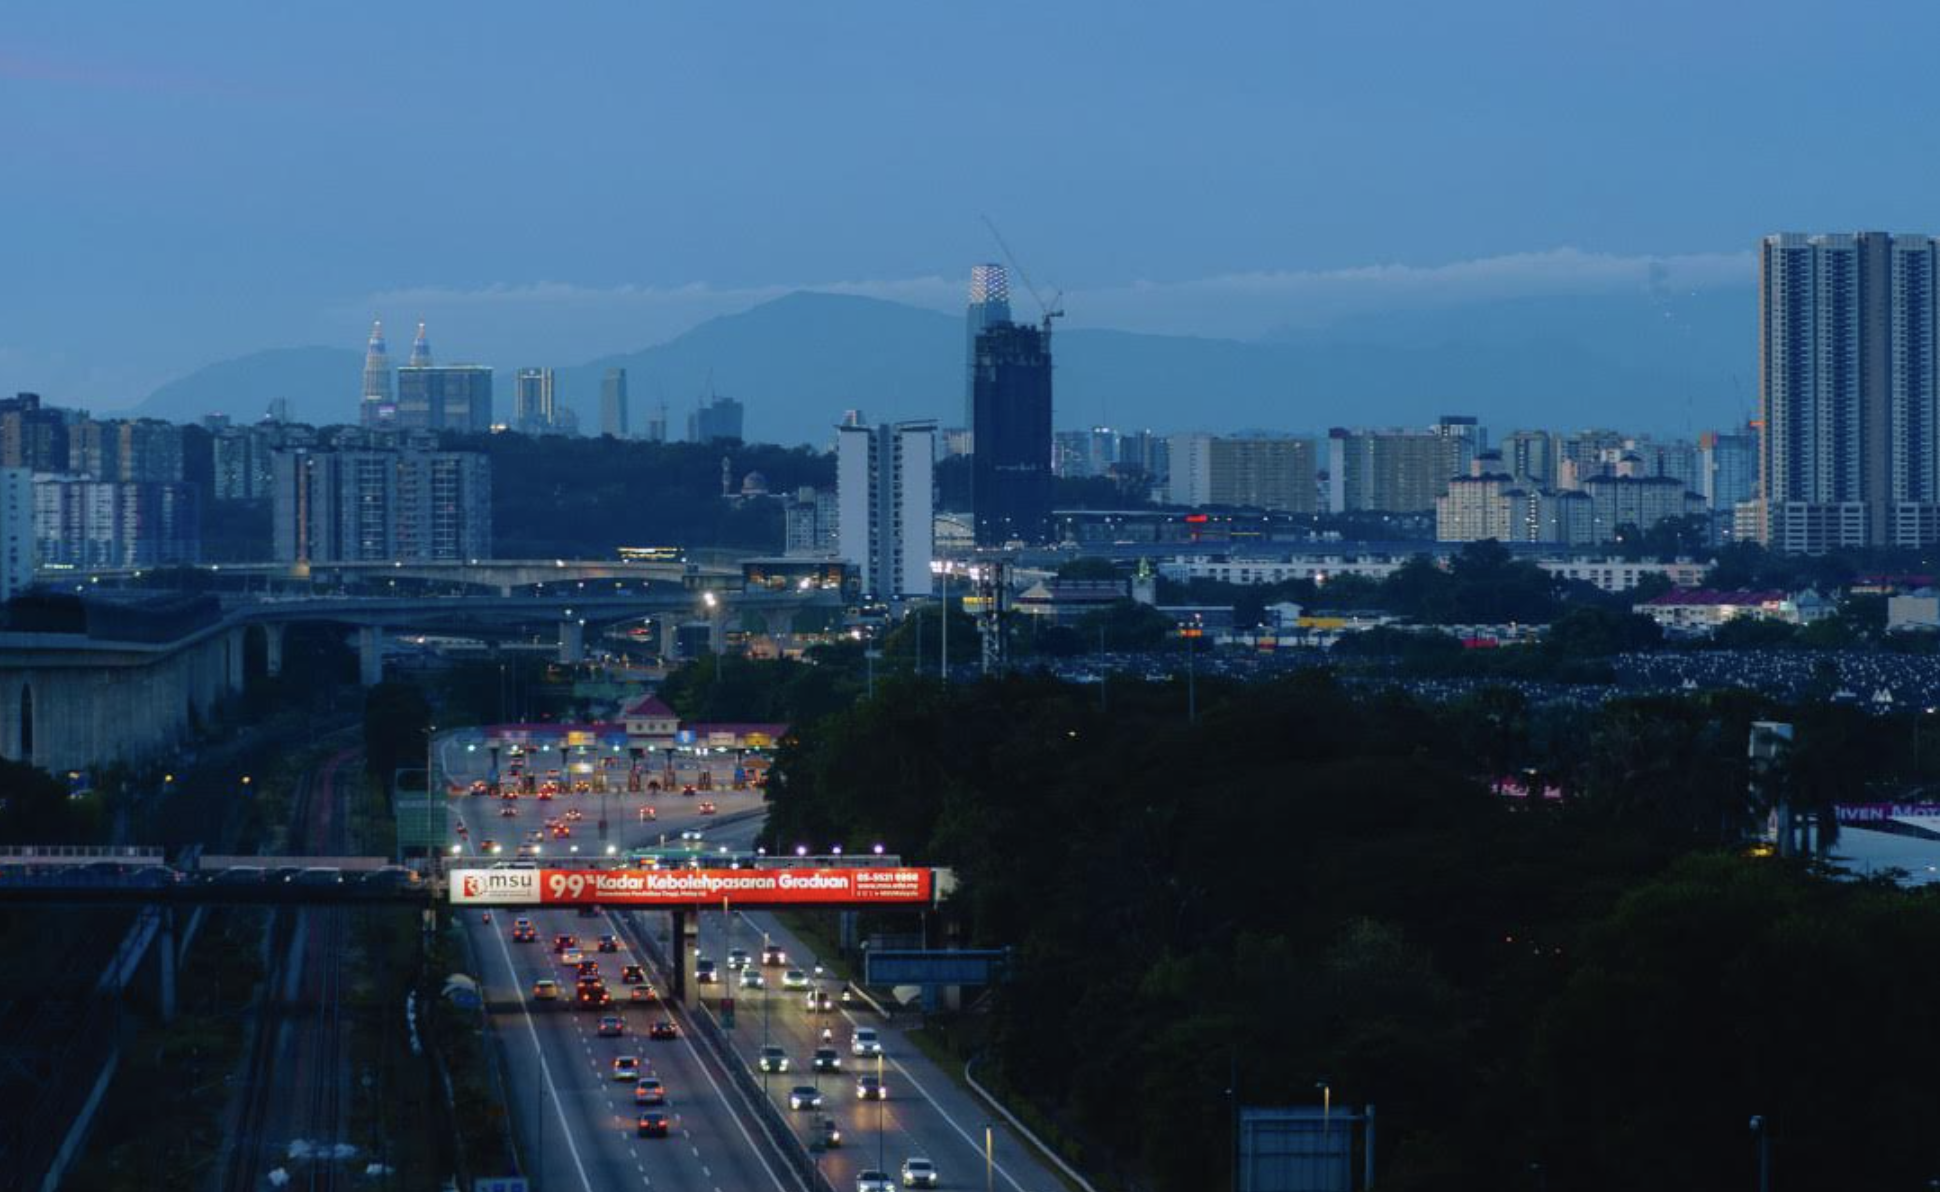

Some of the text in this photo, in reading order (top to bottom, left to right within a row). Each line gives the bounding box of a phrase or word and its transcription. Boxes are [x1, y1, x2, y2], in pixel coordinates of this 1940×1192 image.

[489, 874, 532, 887] msu
[596, 874, 644, 890] Kadar
[647, 873, 775, 893] Kebolehpasaran
[779, 873, 849, 889] Graduan
